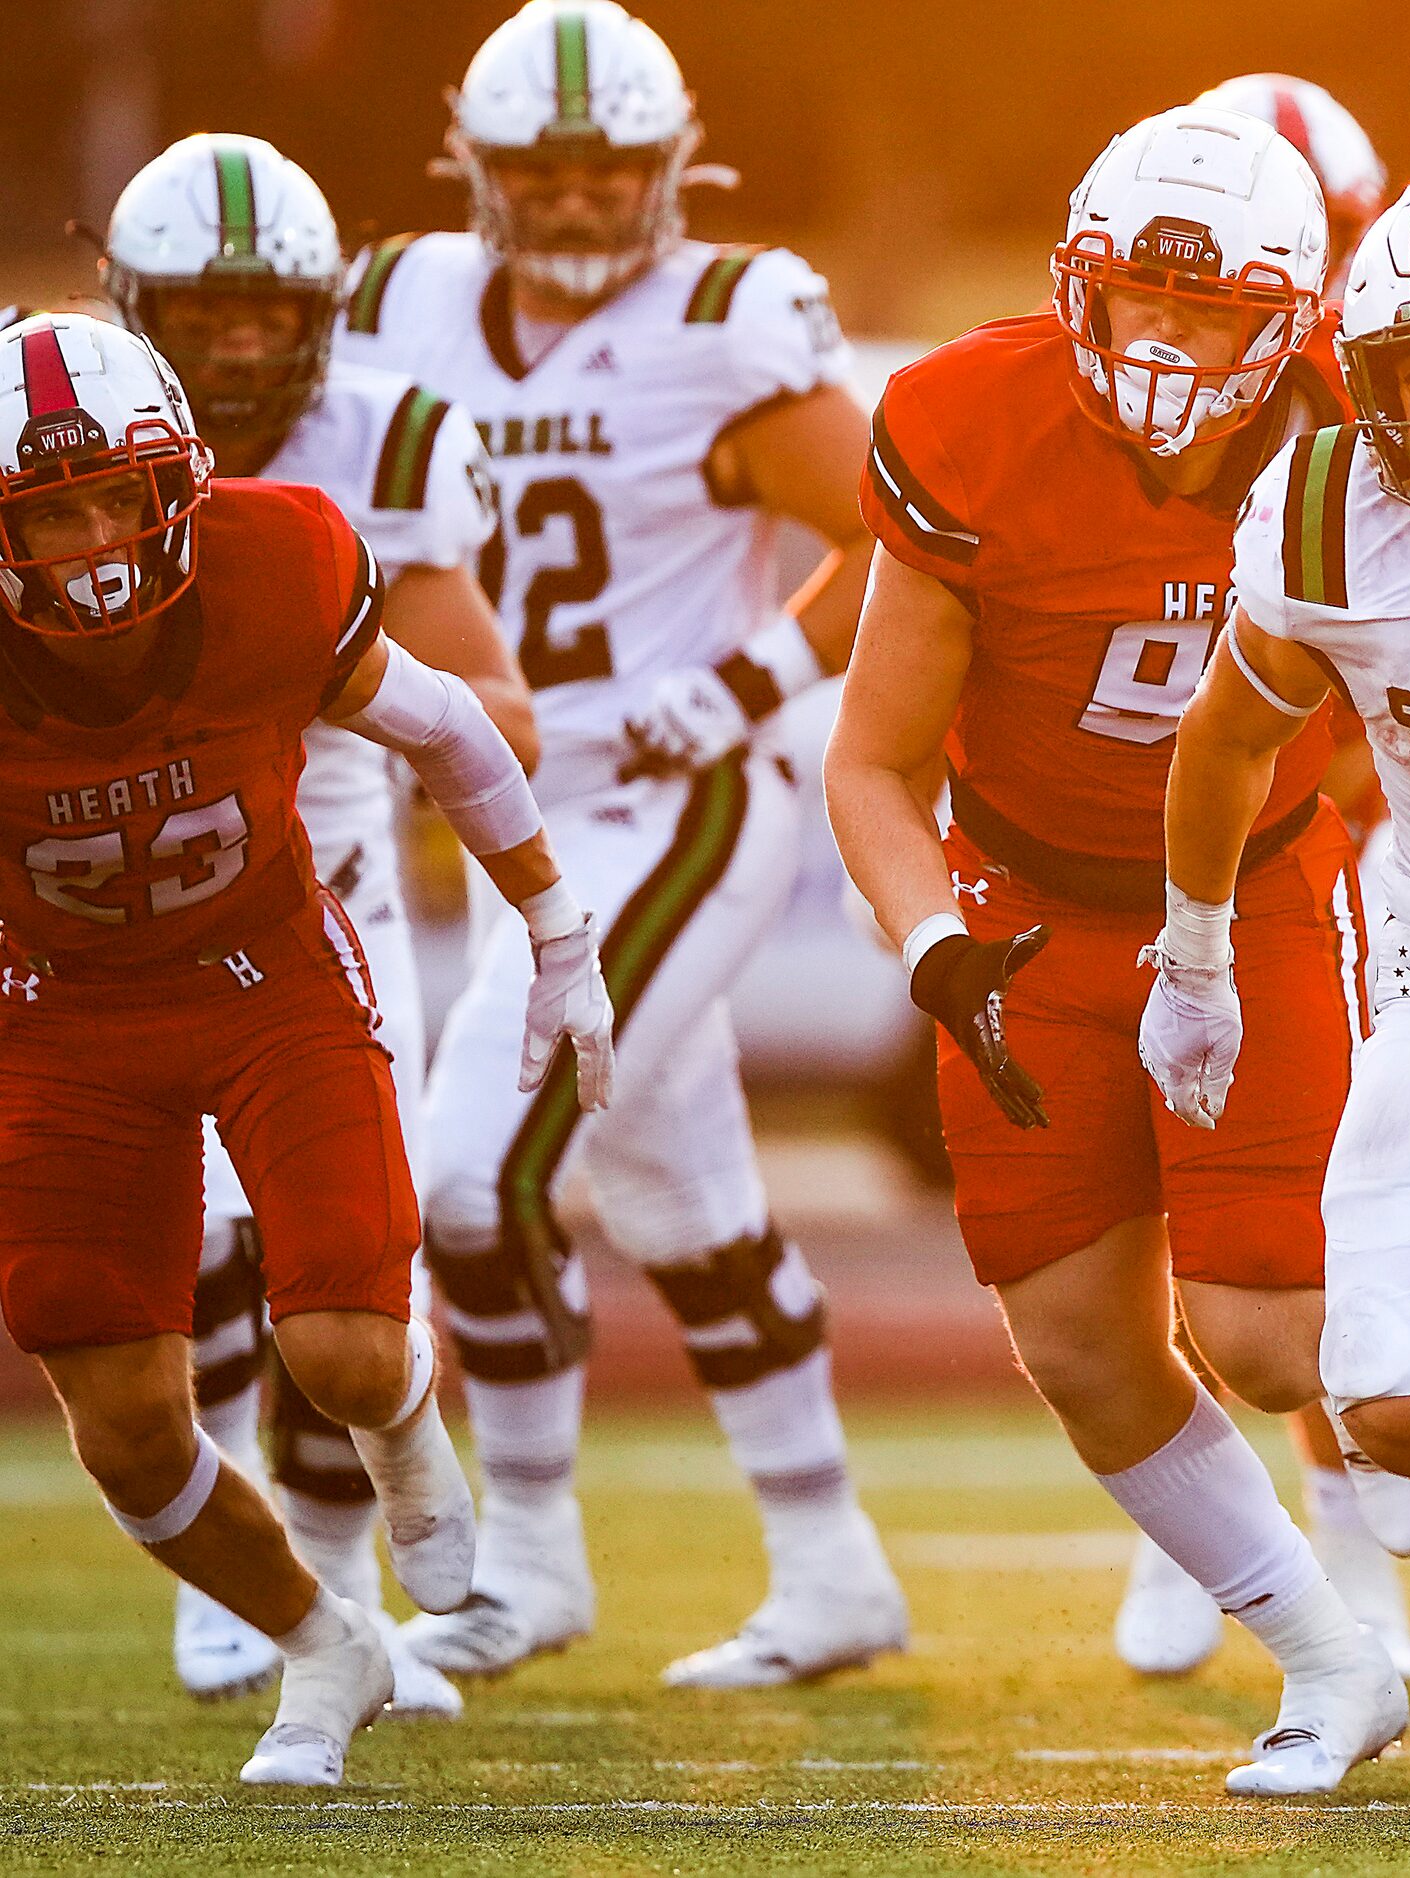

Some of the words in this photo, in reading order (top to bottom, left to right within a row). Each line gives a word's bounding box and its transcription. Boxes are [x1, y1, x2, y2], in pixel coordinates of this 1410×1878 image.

[1159, 238, 1195, 259] WTD
[1151, 346, 1179, 363] BATTLE
[40, 428, 79, 451] WTD
[1077, 618, 1214, 745] 9
[47, 759, 195, 825] HEATH
[25, 793, 249, 924] 23
[222, 949, 265, 989] H
